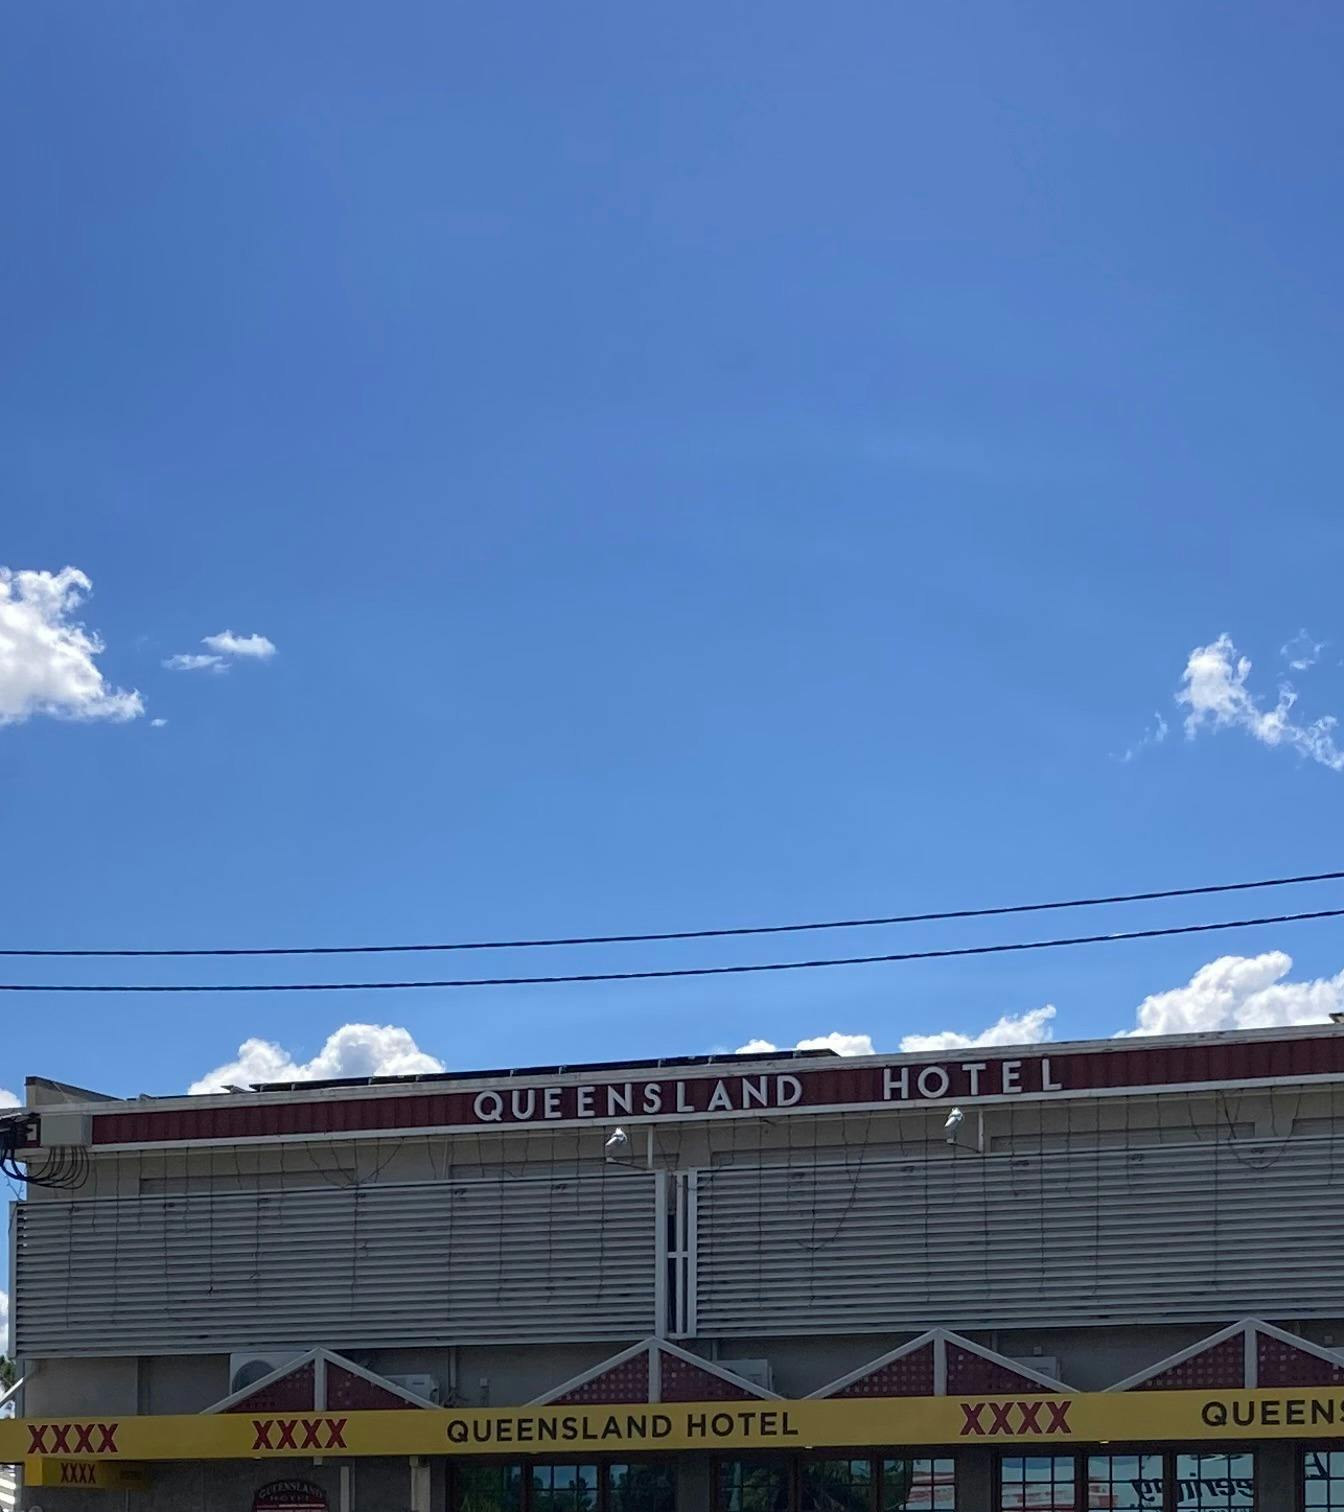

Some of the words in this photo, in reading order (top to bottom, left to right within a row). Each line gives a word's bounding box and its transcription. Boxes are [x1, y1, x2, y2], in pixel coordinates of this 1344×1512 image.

[472, 1074, 804, 1122] QUEENSLAND
[883, 1058, 1064, 1101] HOTEL
[251, 1418, 348, 1450] XXXX
[446, 1414, 673, 1443] QUEENSLAND
[687, 1411, 799, 1438] HOTEL
[959, 1400, 1072, 1436] XXXX
[27, 1424, 118, 1454] XXXX
[60, 1462, 96, 1485] XXXX
